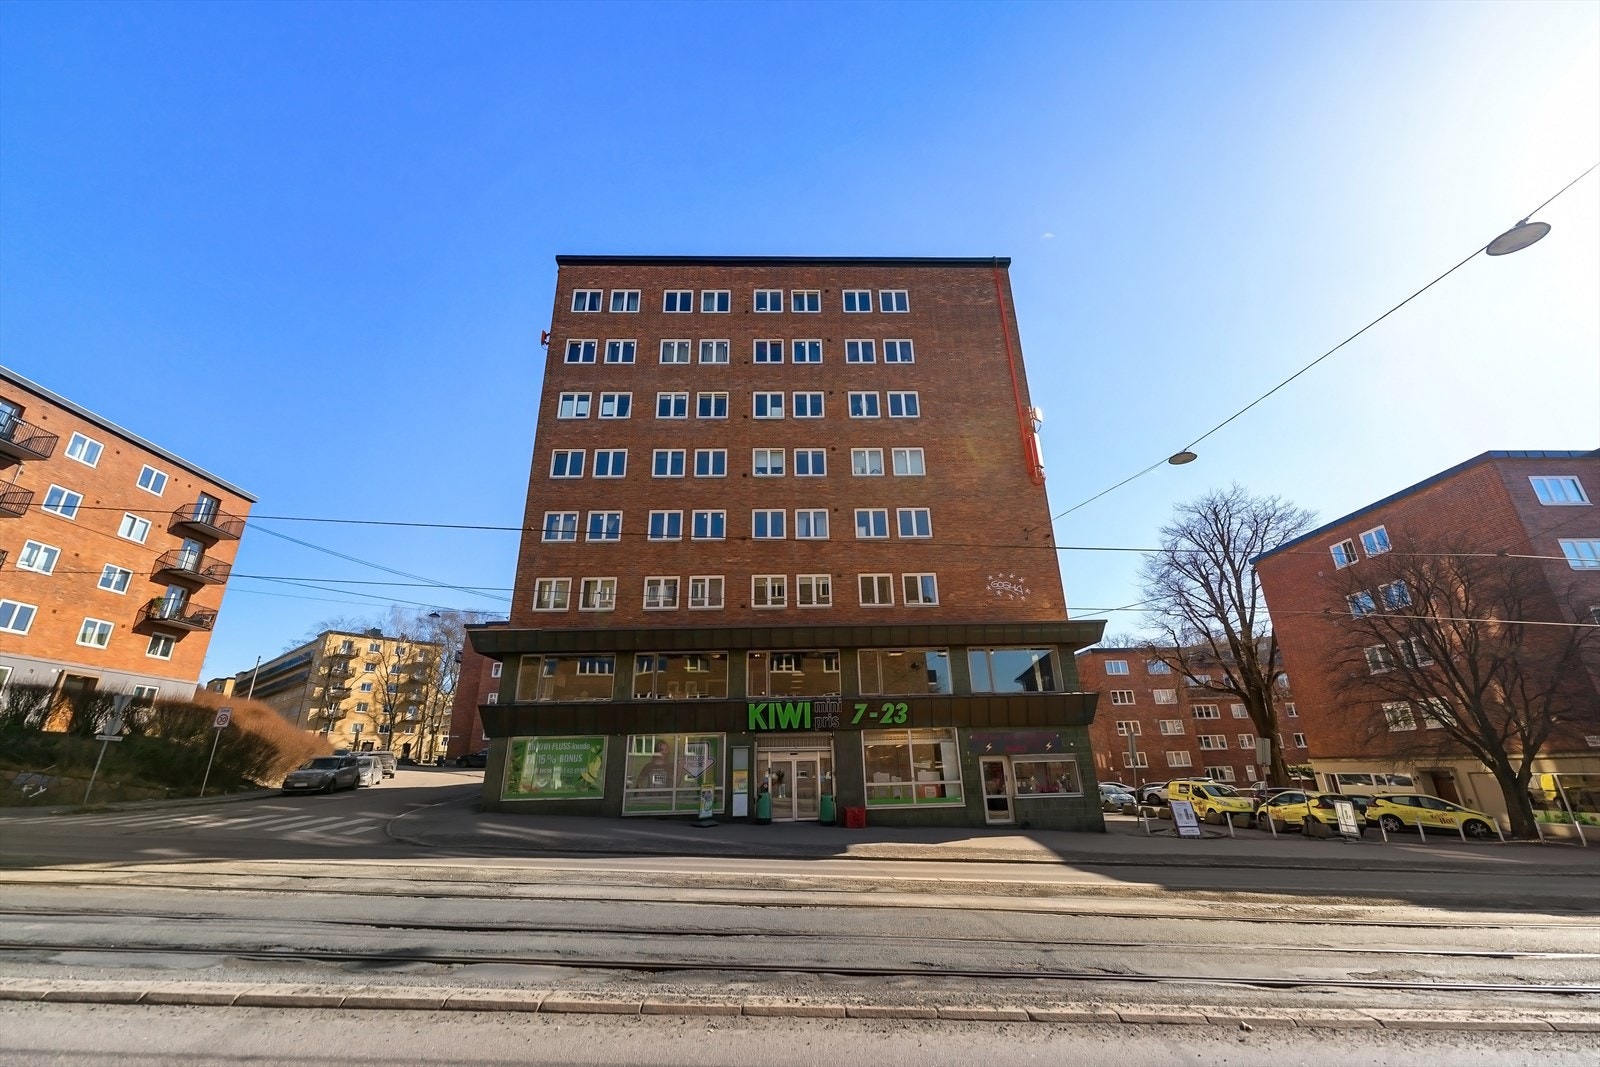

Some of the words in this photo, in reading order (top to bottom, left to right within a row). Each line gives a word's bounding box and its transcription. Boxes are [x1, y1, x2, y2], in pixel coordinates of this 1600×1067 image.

[814, 698, 842, 713] mini
[748, 703, 811, 730] KIWI
[814, 713, 840, 730] pris
[560, 754, 583, 763] BONUS
